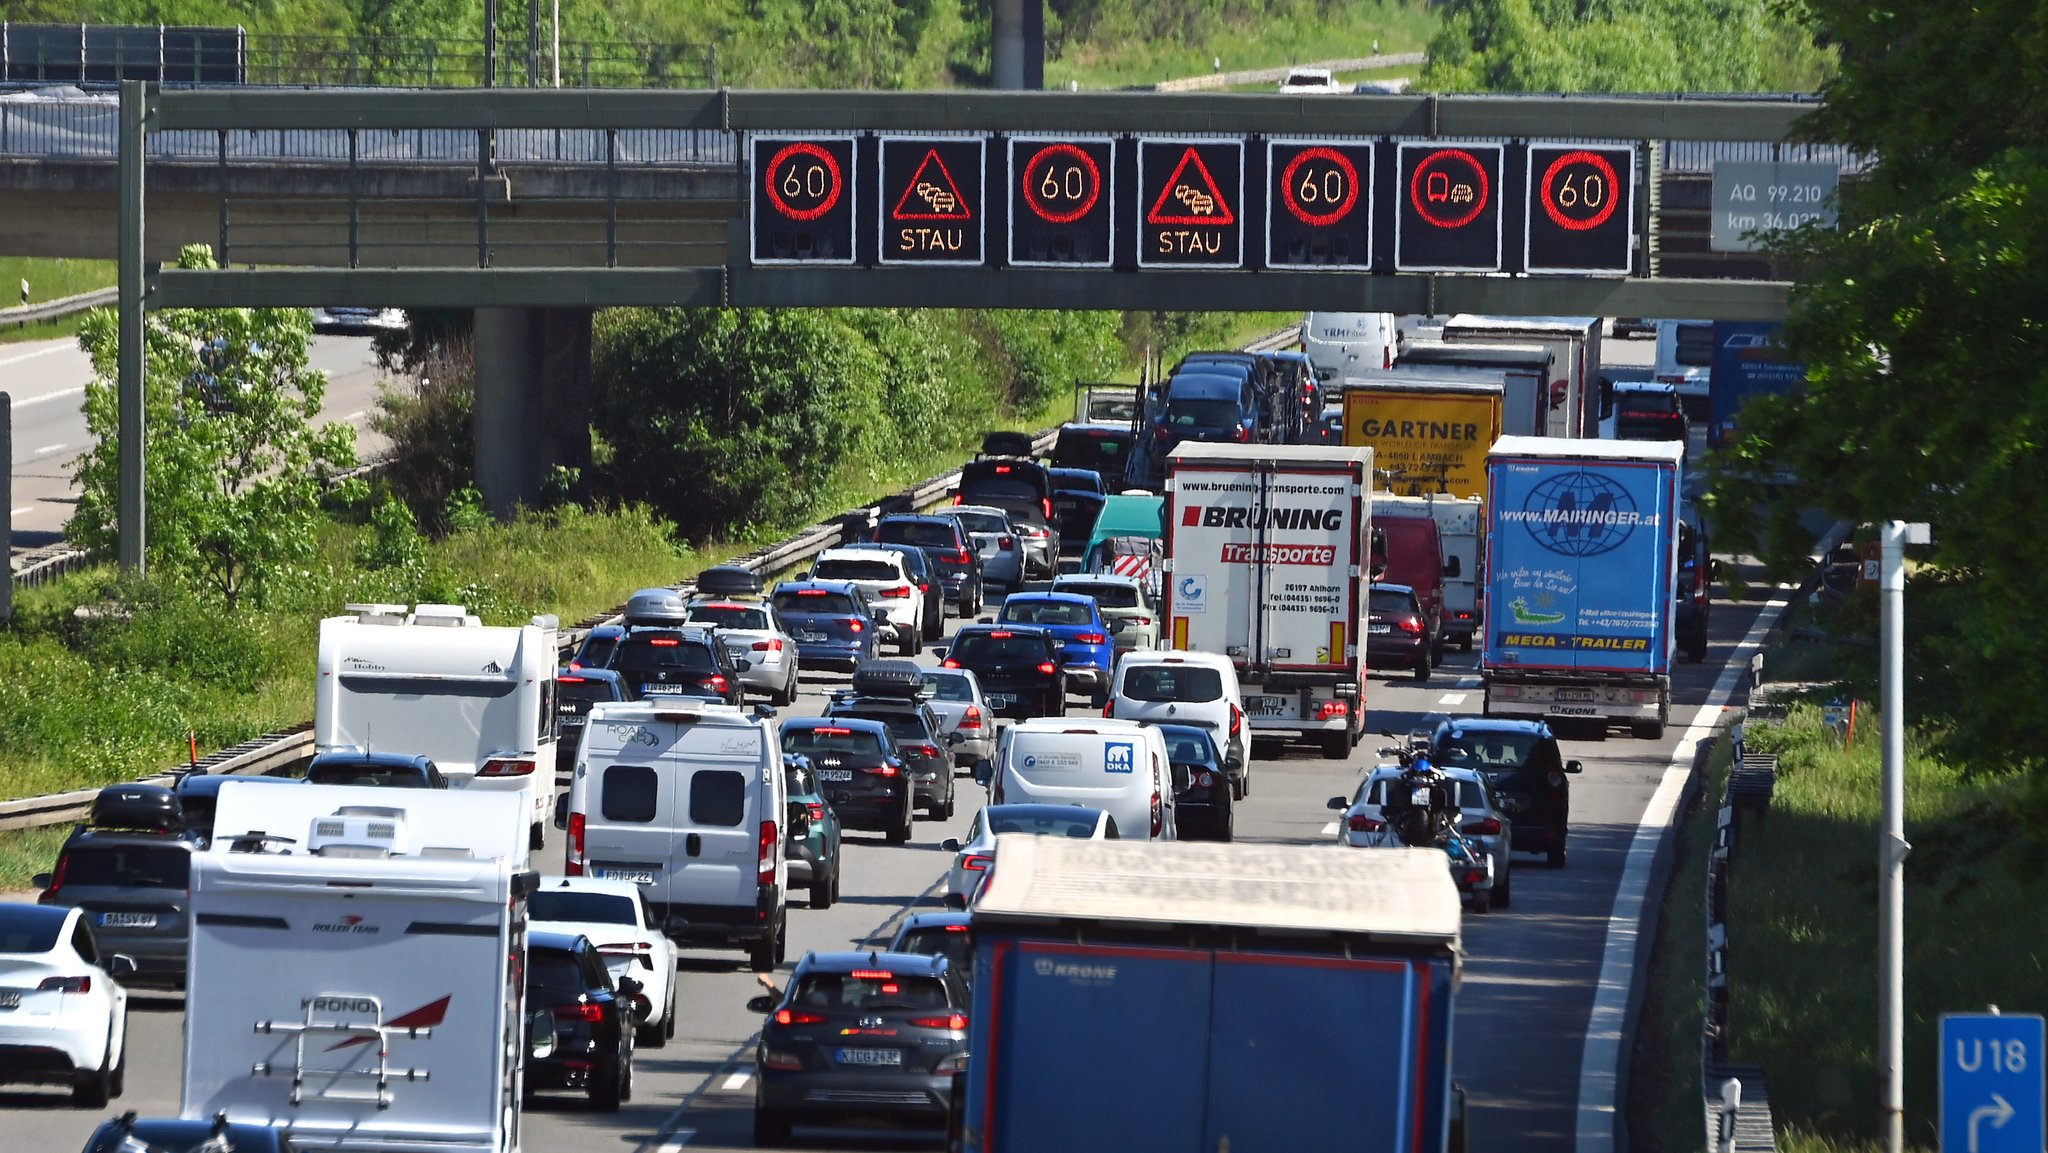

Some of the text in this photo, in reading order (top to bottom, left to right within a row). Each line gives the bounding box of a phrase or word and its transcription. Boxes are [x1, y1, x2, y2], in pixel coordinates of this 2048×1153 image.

[783, 164, 826, 198] 60
[1041, 166, 1083, 200] 60
[1300, 169, 1342, 203] 60
[1558, 173, 1603, 208] 60
[1730, 184, 1822, 203] AQ 99.210
[1727, 212, 1756, 230] km
[900, 228, 964, 252] STAU
[1158, 231, 1222, 255] STAU
[1361, 419, 1478, 441] GARTNER
[1203, 503, 1343, 531] BRÜNING
[1500, 508, 1661, 527] www.MAIRINGER.at
[1225, 545, 1333, 563] Transporte
[1285, 583, 1307, 592] 26197
[1505, 635, 1556, 646] MEGA
[1571, 637, 1647, 649] TRAILER
[354, 663, 385, 671] Hobby
[607, 725, 647, 734] ROAD
[606, 871, 618, 880] FO
[638, 873, 649, 881] 22
[312, 924, 379, 933] ROLLER TEAM
[1055, 965, 1116, 979] KRONE
[300, 998, 383, 1013] KRONOS
